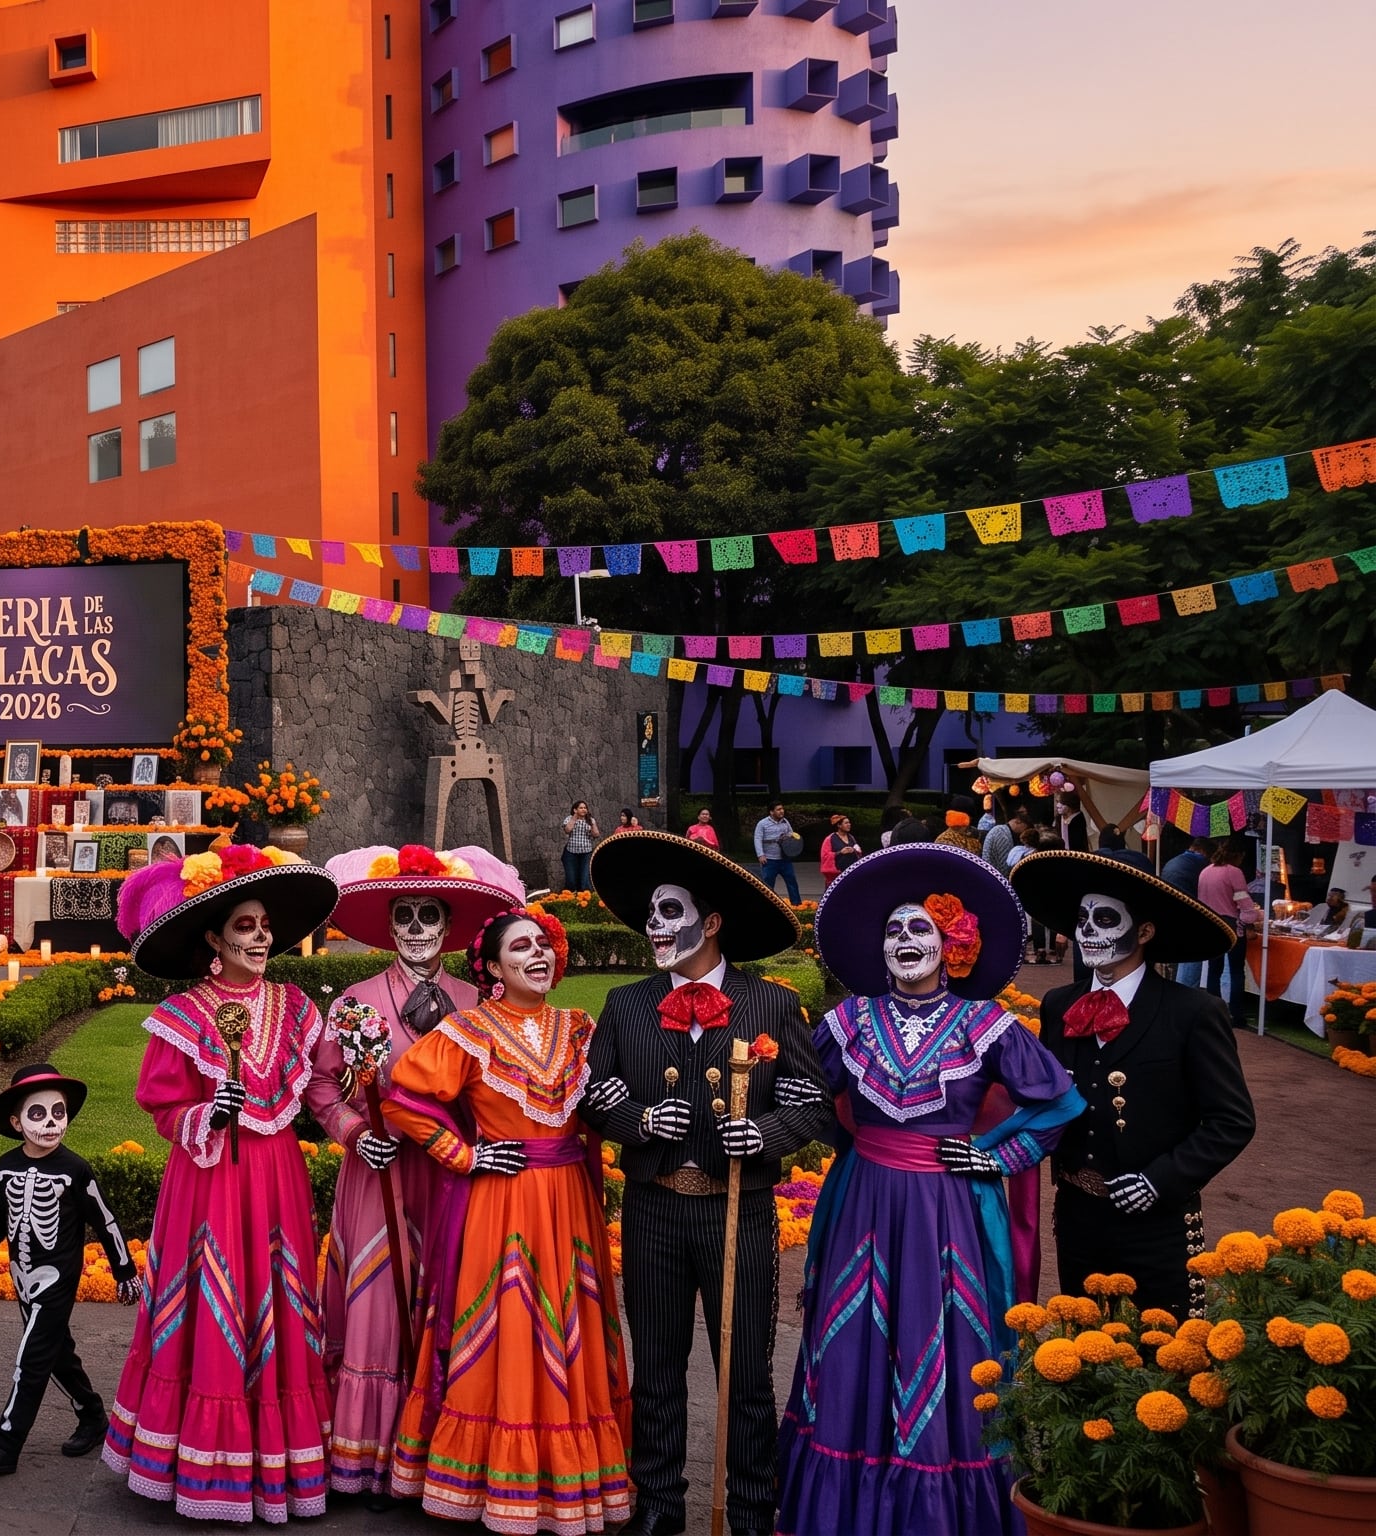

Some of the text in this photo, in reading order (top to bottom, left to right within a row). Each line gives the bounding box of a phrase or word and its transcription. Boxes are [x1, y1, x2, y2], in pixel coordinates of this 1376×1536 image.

[83, 596, 104, 614] DE
[83, 615, 114, 635] LAS
[0, 692, 62, 720] 2026
